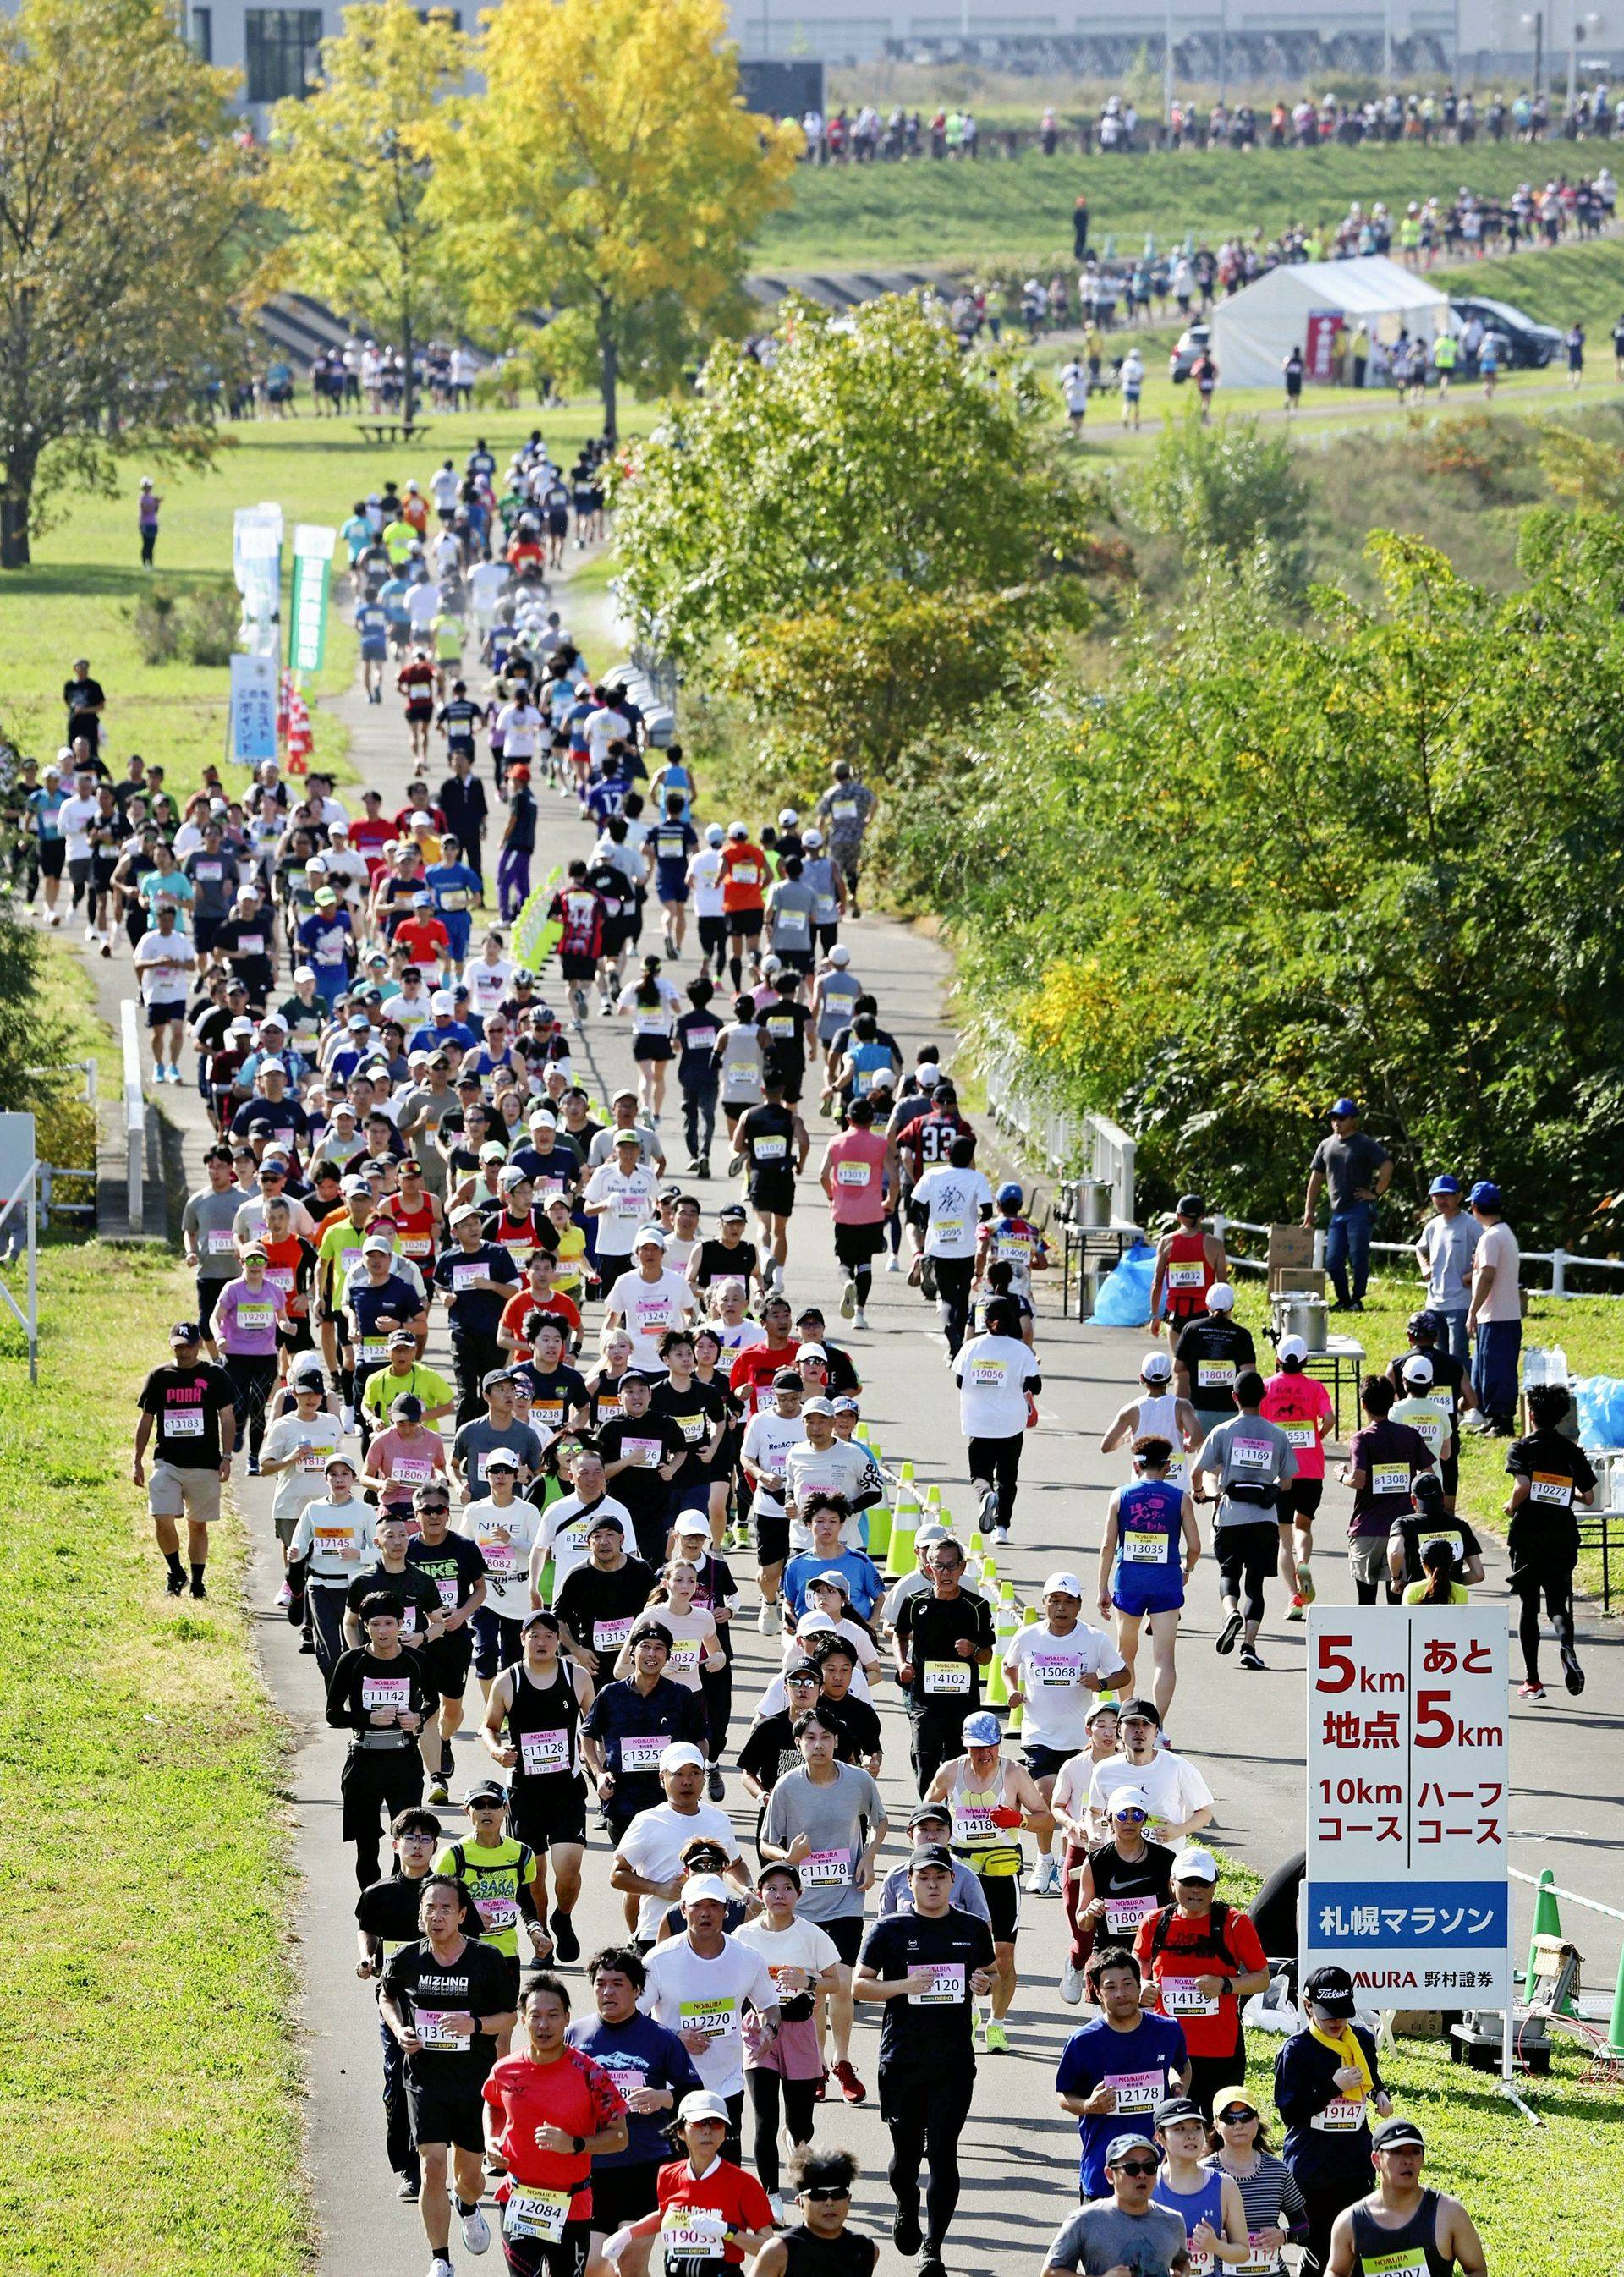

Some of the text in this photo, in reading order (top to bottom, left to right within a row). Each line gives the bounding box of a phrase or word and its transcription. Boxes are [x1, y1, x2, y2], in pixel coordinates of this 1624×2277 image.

[923, 1127, 956, 1162] 33
[532, 1410, 560, 1419] 10238
[164, 1419, 200, 1429] C13183
[1287, 1431, 1311, 1441] 5531
[1234, 1449, 1270, 1461] C11169
[393, 1470, 428, 1481] C18067
[1533, 1482, 1567, 1496] E10272
[315, 1539, 350, 1548] E17145
[1126, 1544, 1164, 1555] B13035
[1423, 1639, 1493, 1675] あと
[1315, 1635, 1405, 1693] 5km
[925, 1674, 965, 1685] B14102
[1034, 1667, 1077, 1679] C15068
[363, 1691, 405, 1703] C11142
[1413, 1690, 1503, 1748] 5km
[1323, 1710, 1400, 1749] 地点
[523, 1742, 565, 1758] C11128
[1319, 1777, 1402, 1804] 10km
[1417, 1782, 1502, 1808] ハーフ
[1319, 1816, 1402, 1842] コース
[1418, 1819, 1502, 1845] コース
[811, 1852, 839, 1861] NOMURA
[800, 1863, 847, 1877] C11178
[469, 1879, 514, 1892] OSAKA
[1115, 1899, 1144, 1907] NOMURA
[1106, 1912, 1144, 1924] C1804
[1320, 1905, 1495, 1936] 札幌マラソン
[418, 1975, 469, 1987] MIZUNO
[1353, 1970, 1494, 1989] MURA 野村證券
[1316, 1989, 1350, 2000] Titleist
[694, 2000, 723, 2010] NOMURA
[682, 2013, 731, 2030] D12270
[1118, 2075, 1150, 2084] NOMURA
[1116, 2088, 1159, 2104] 12178
[1325, 2105, 1362, 2119] 19147
[527, 2189, 557, 2198] NOMURA
[509, 2199, 562, 2220] B12084
[1374, 2254, 1409, 2267] NOMURA
